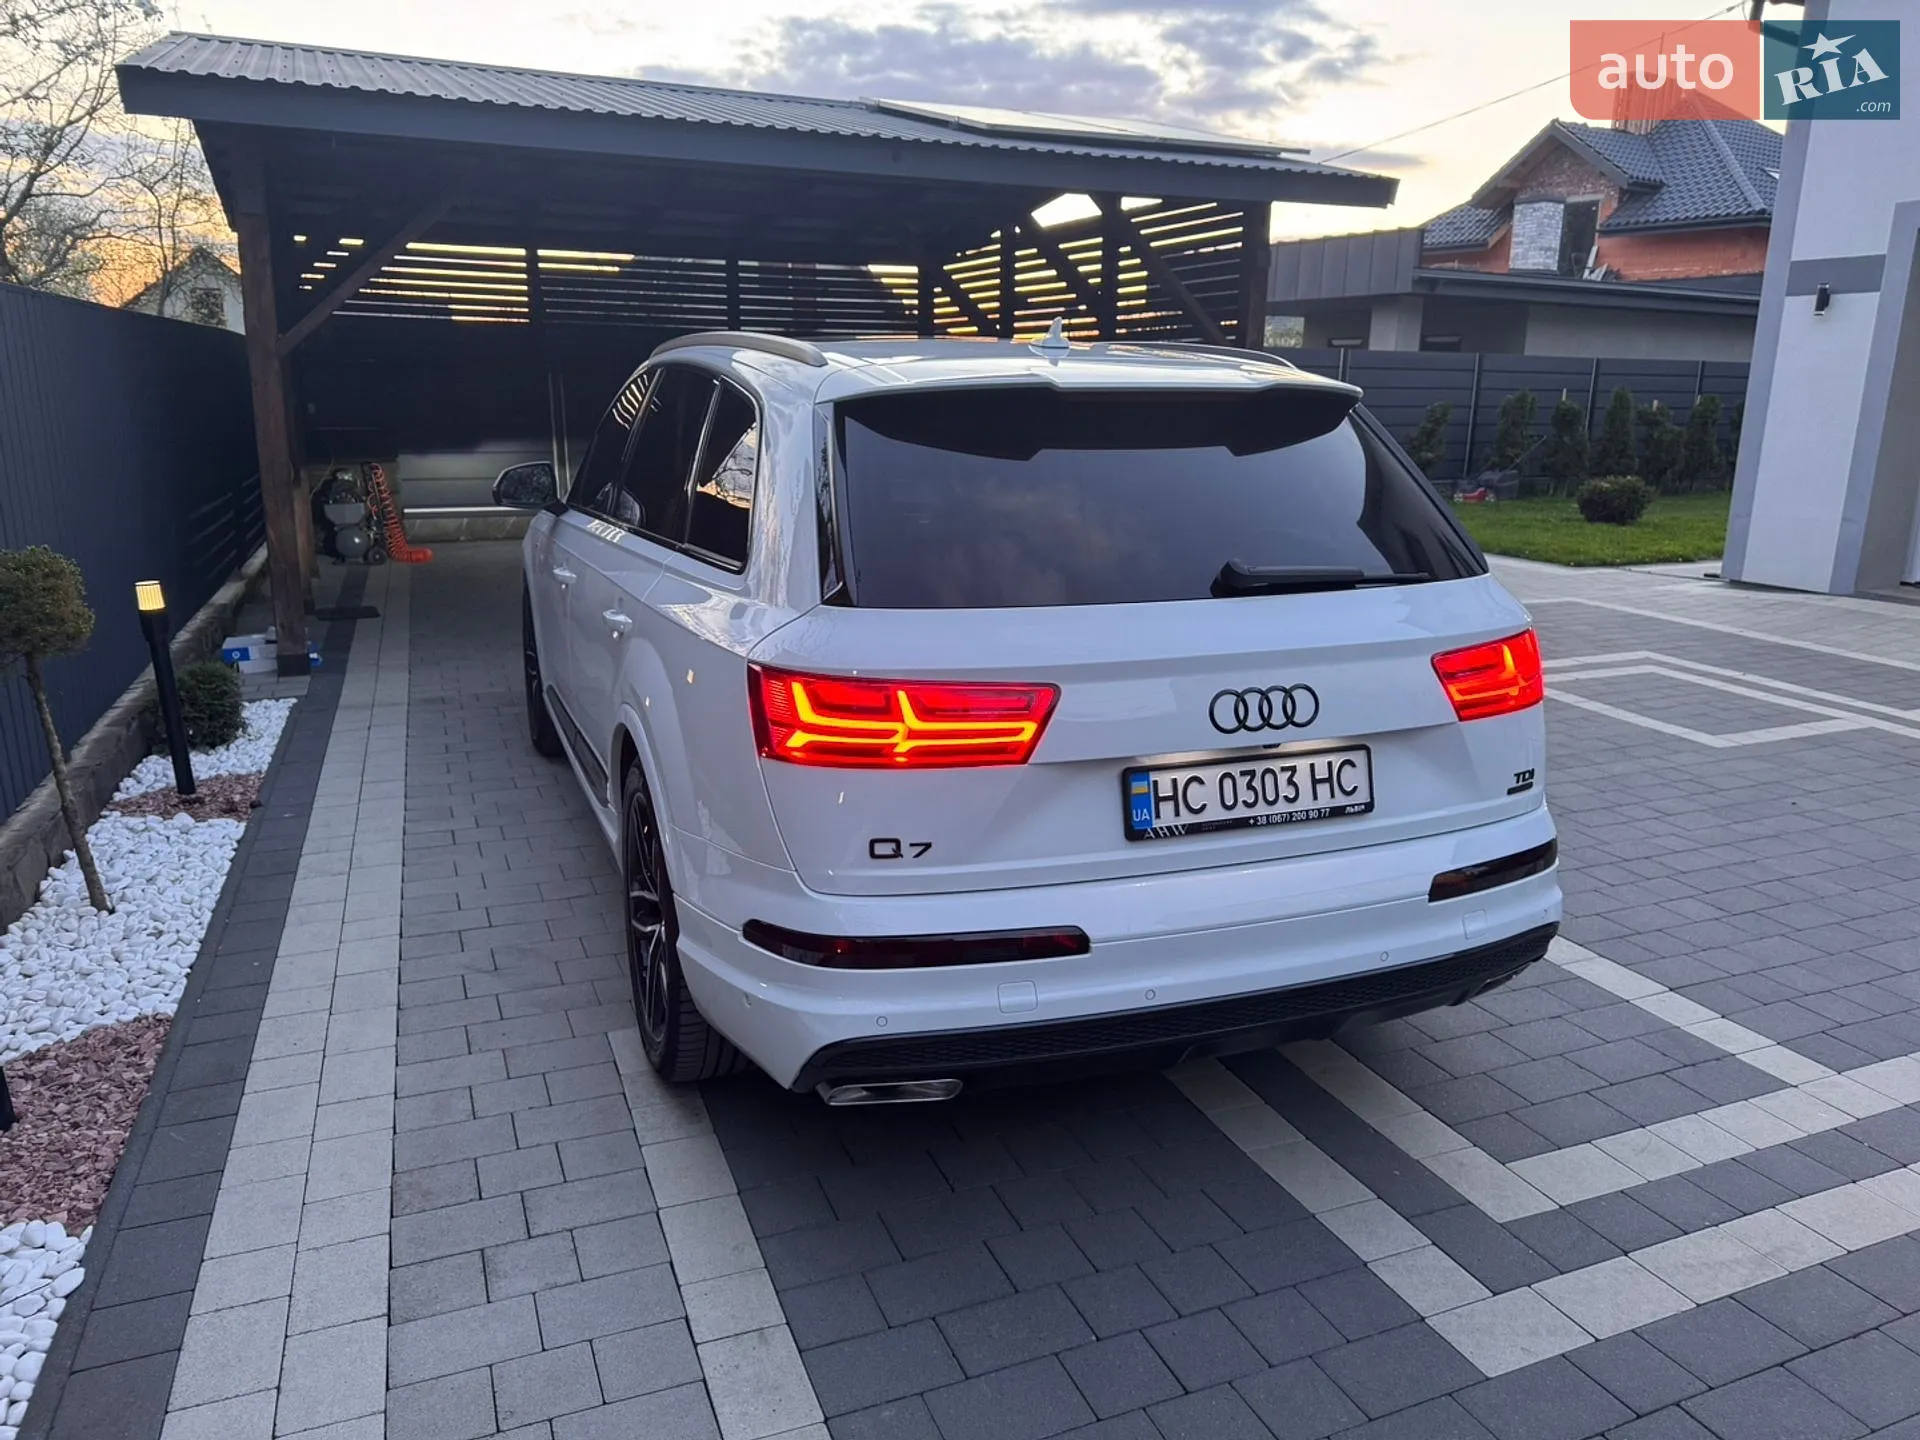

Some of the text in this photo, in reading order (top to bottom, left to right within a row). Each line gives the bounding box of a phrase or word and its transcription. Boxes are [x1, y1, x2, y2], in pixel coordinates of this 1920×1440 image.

[1152, 758, 1359, 819] HC 0303 HC
[1133, 807, 1150, 821] UA
[1308, 809, 1319, 819] 90
[1320, 808, 1331, 817] 77
[869, 838, 932, 859] Q7
